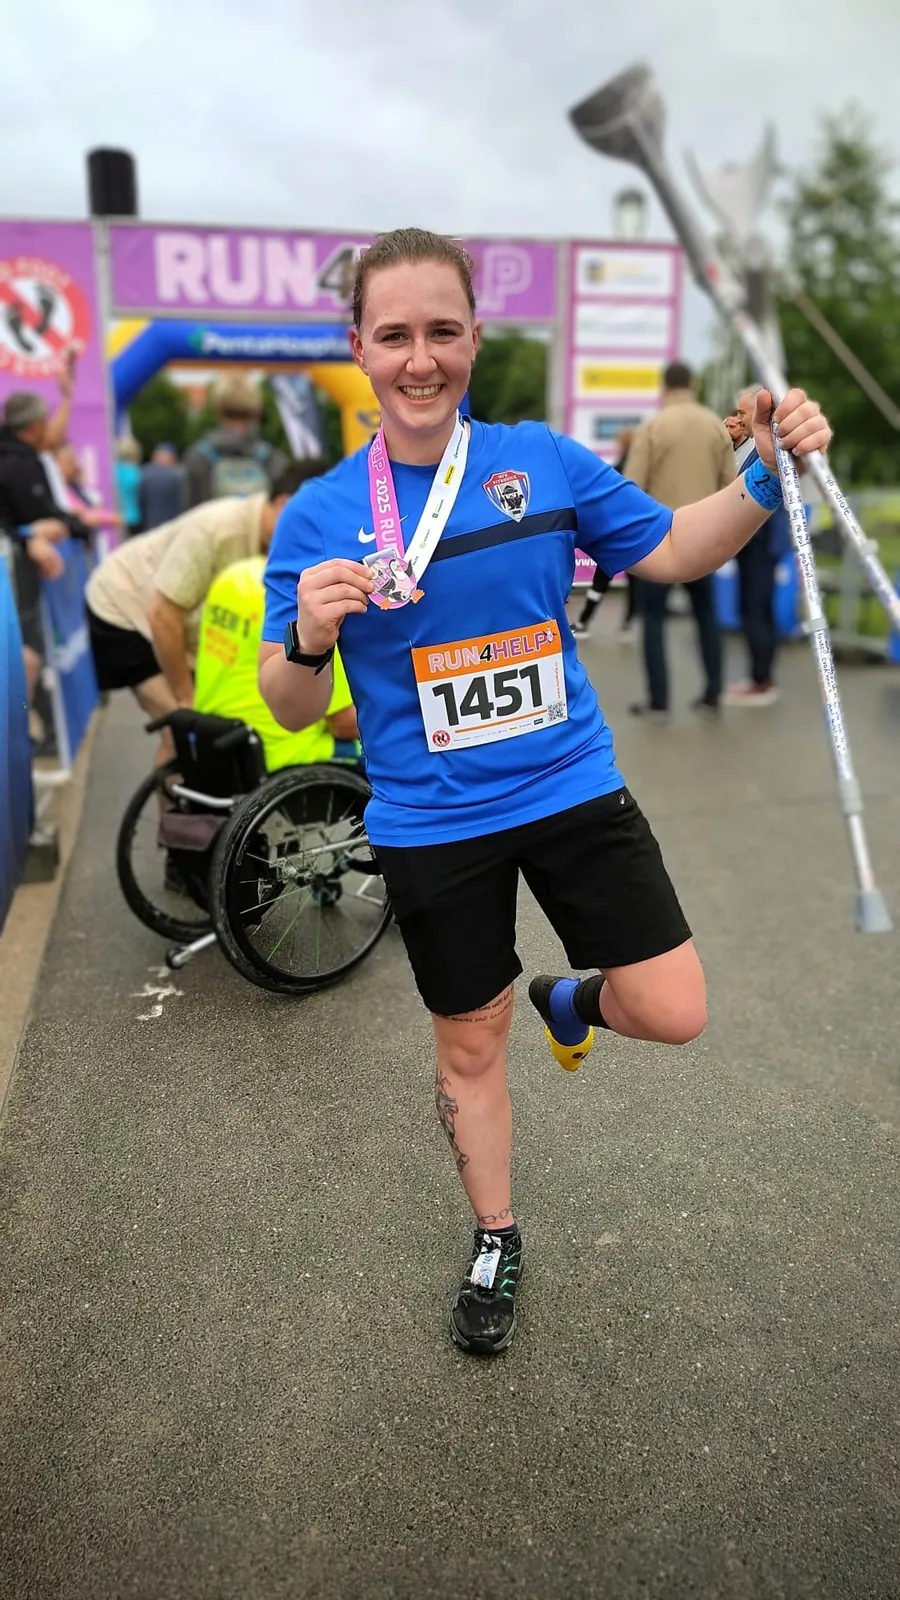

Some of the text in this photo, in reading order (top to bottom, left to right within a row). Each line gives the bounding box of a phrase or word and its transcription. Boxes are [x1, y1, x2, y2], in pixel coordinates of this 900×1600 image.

[375, 475, 392, 514] 2025
[428, 631, 548, 673] RUN4HELP
[432, 664, 542, 726] 1451
